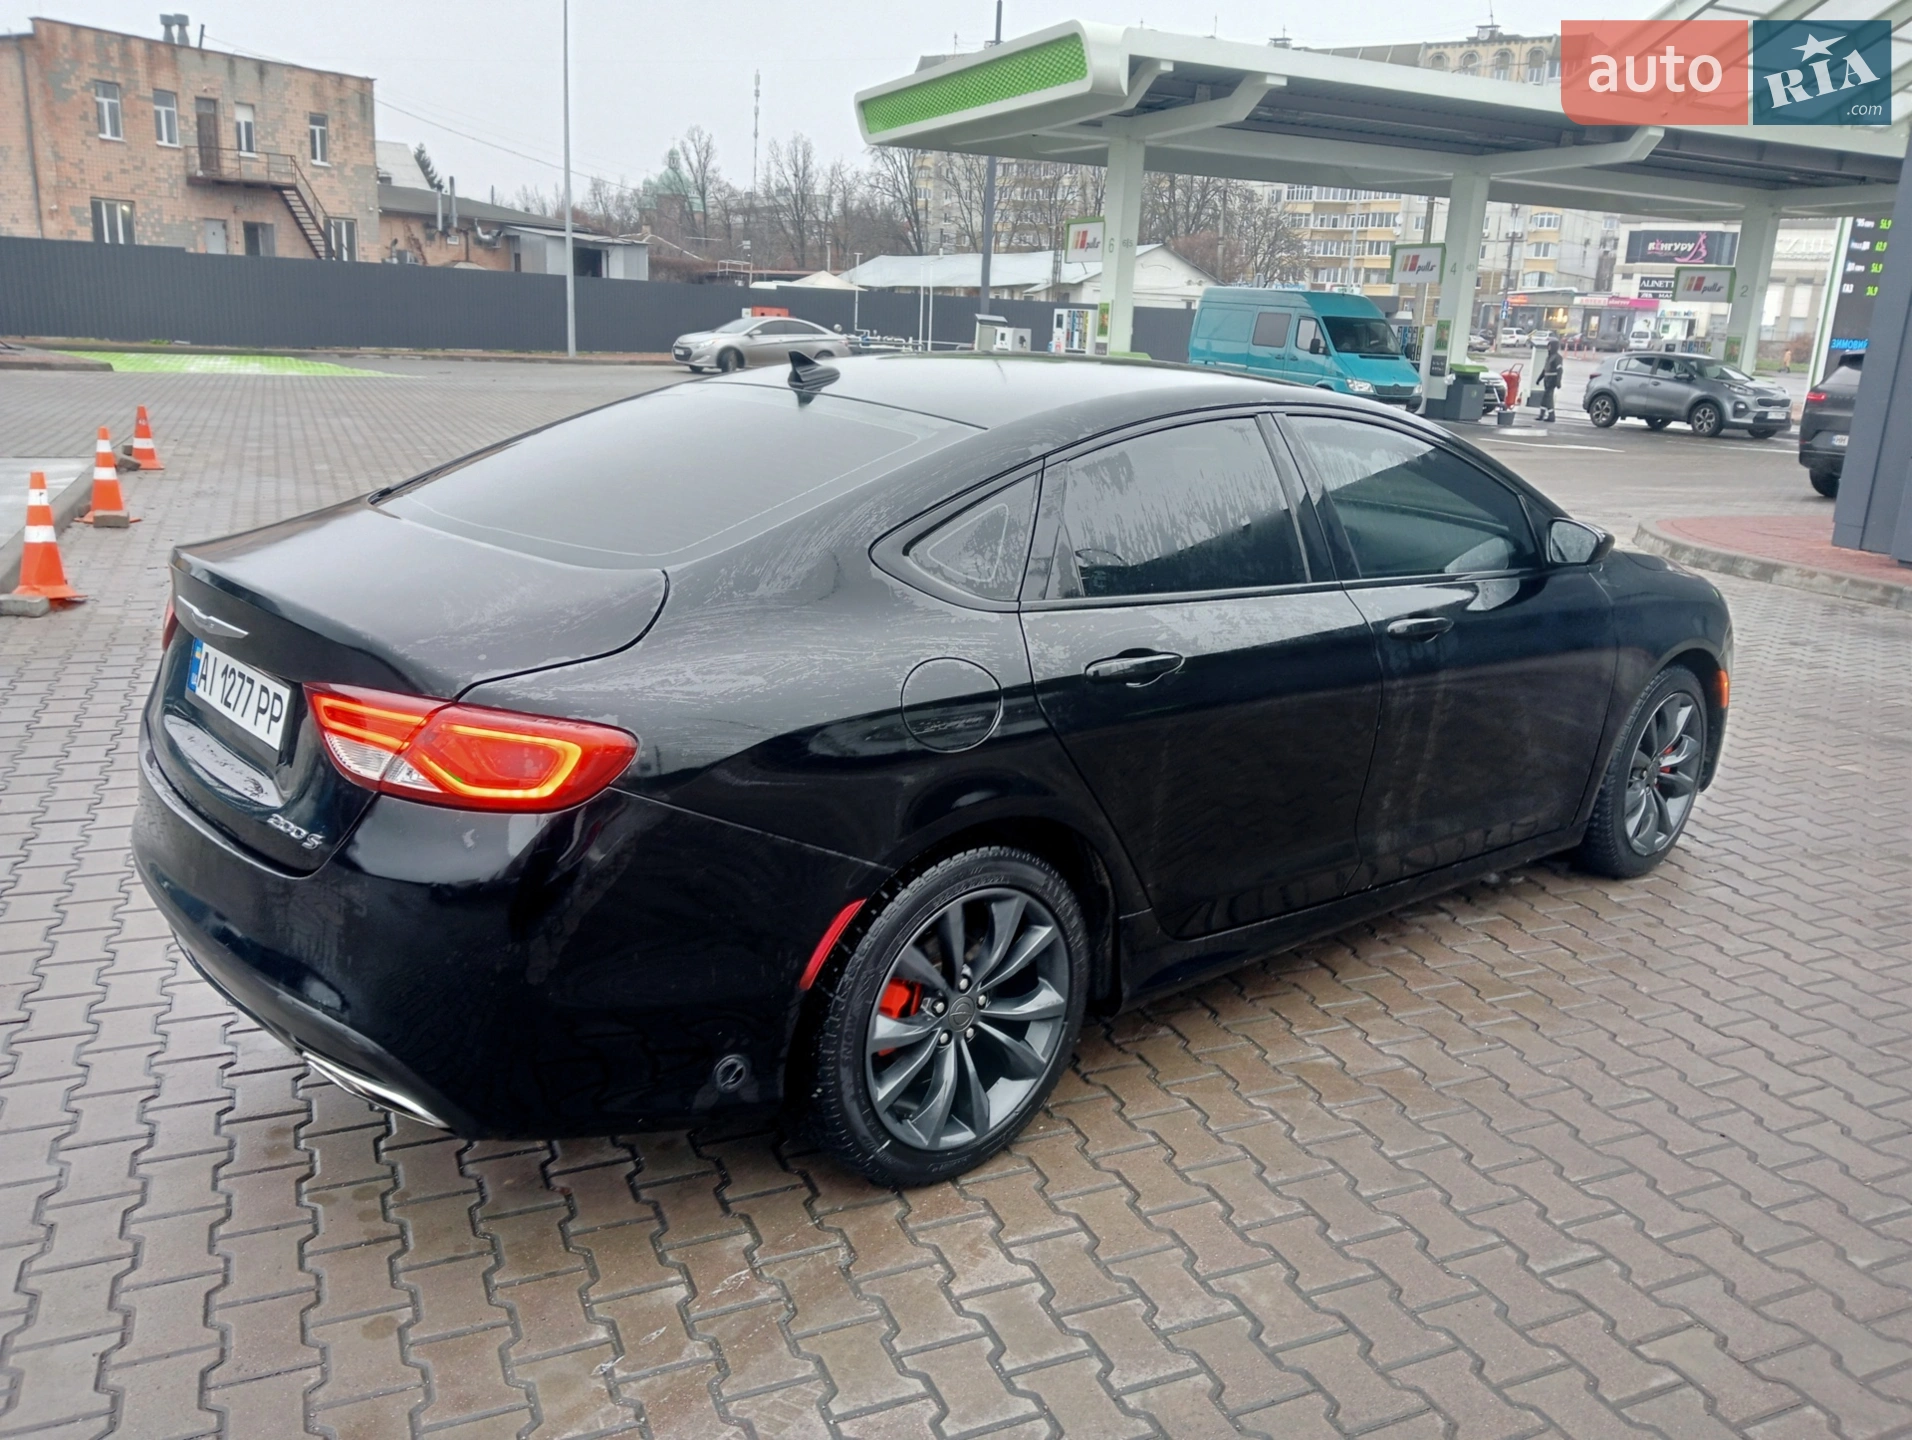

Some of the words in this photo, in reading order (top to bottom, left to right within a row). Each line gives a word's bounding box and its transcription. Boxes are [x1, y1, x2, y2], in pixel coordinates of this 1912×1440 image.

[1108, 237, 1115, 253] 6
[1416, 260, 1437, 275] pulls
[1450, 262, 1457, 276] 4
[1701, 282, 1724, 295] pulls
[1740, 285, 1749, 298] 2
[197, 651, 218, 697] AI
[220, 663, 255, 718] 1277
[253, 683, 284, 735] PP
